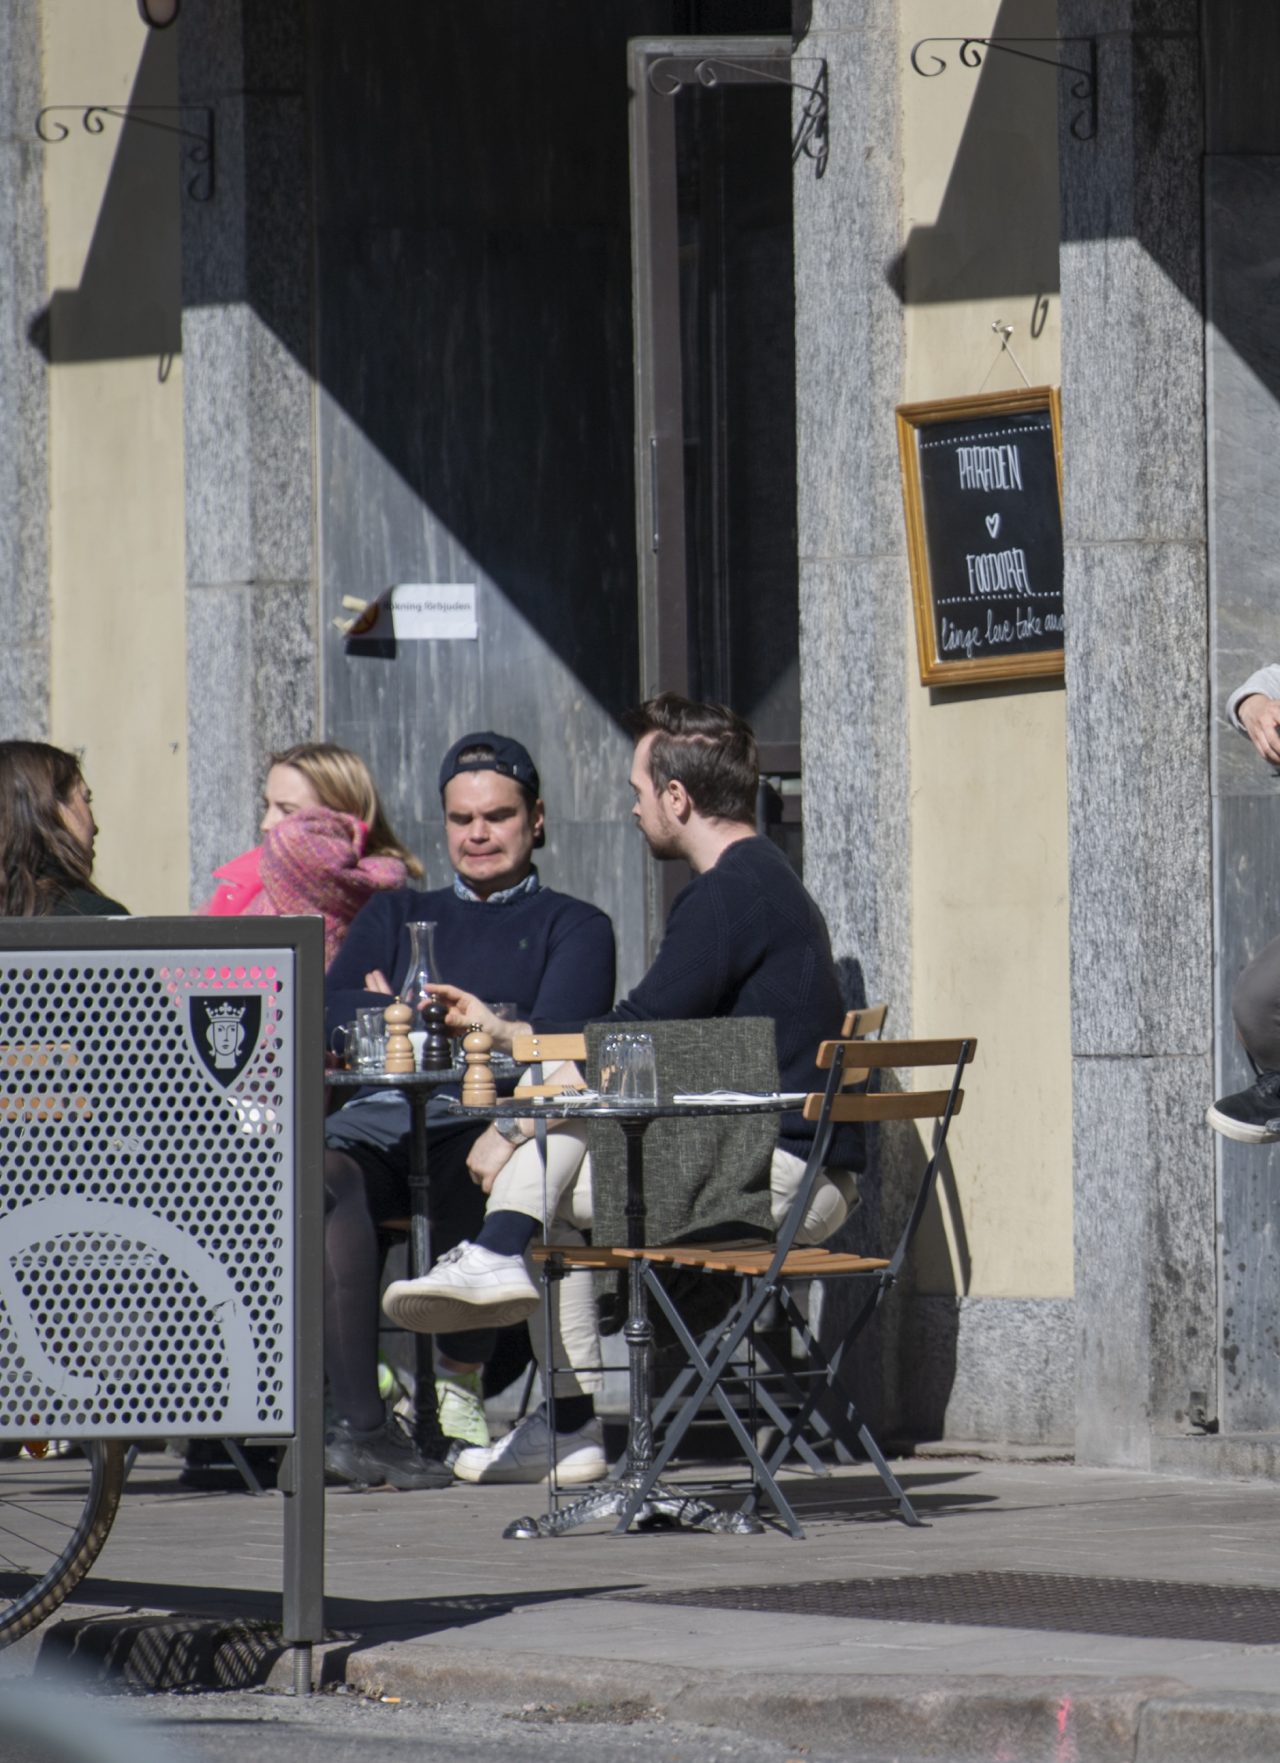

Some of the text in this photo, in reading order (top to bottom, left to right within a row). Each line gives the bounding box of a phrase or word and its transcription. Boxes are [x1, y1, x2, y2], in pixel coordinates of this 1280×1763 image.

[956, 444, 1023, 492] PARADEN
[966, 548, 1032, 595] FOODORA
[424, 602, 471, 613] förbjuden
[1016, 606, 1043, 640] take
